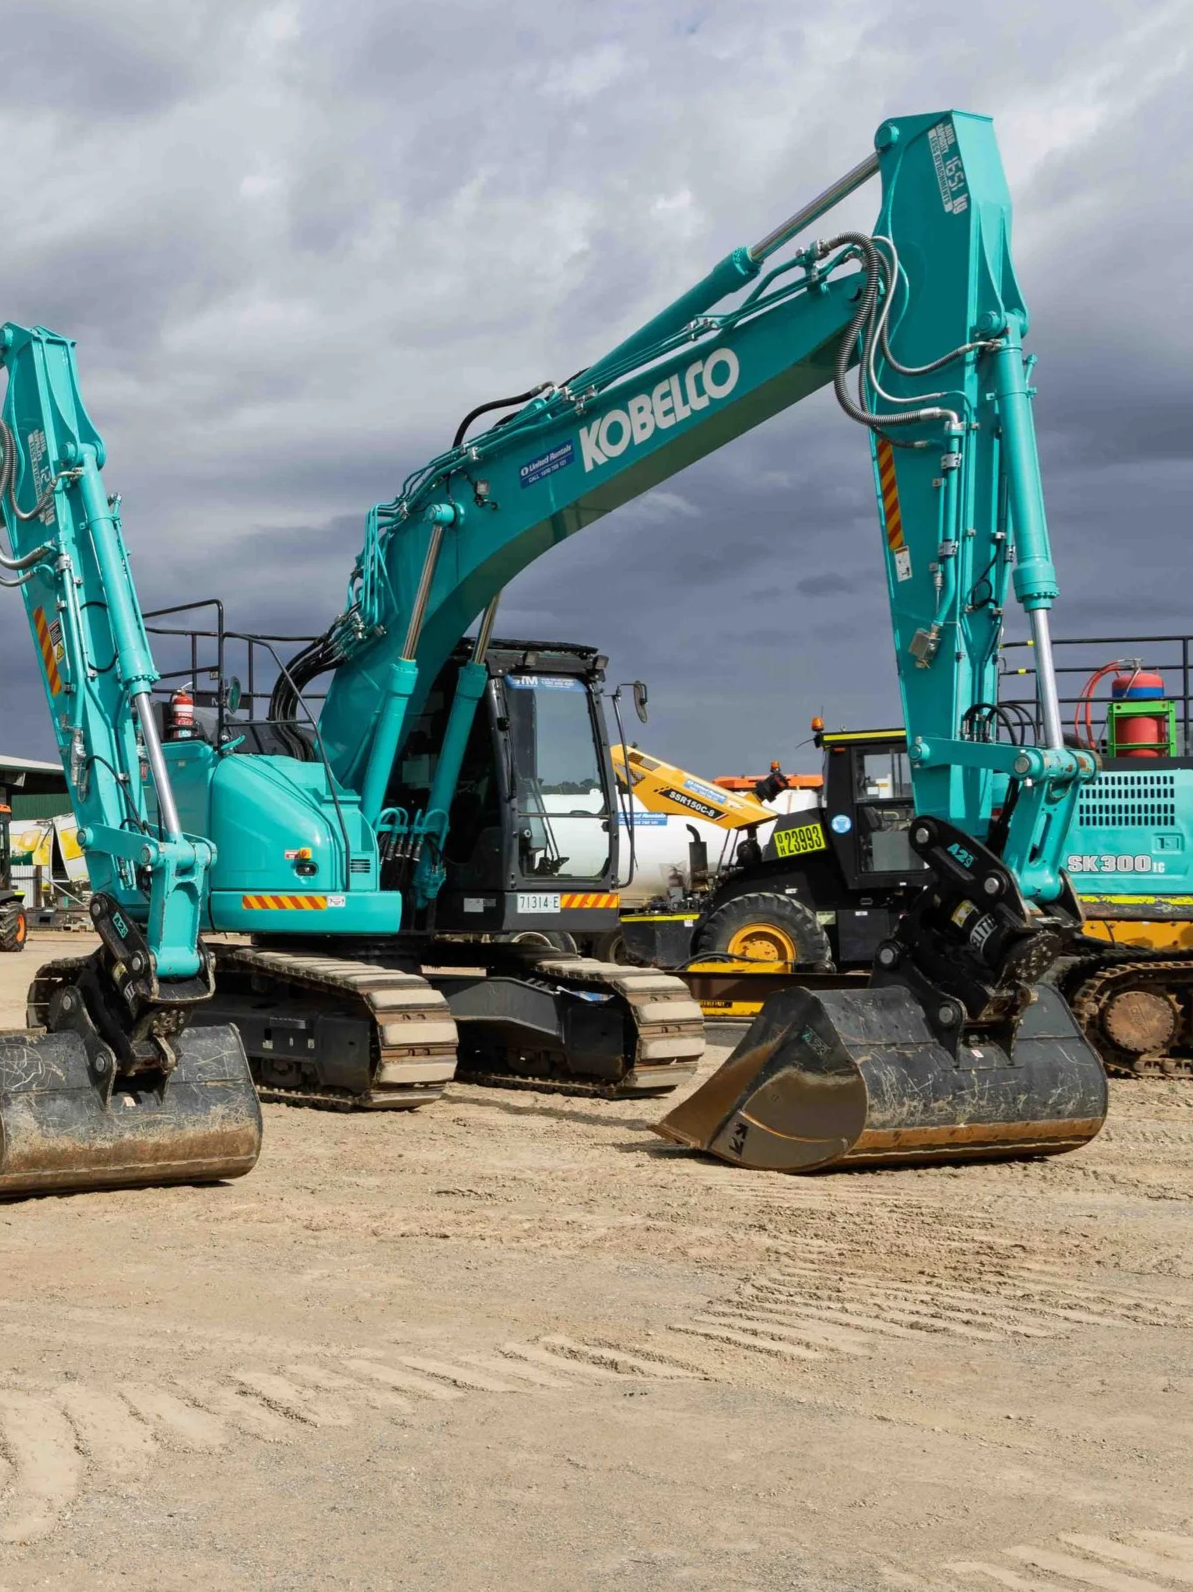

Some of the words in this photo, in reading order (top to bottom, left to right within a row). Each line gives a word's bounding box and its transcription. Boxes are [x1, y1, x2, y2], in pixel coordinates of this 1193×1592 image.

[579, 348, 739, 473] KOBELCO
[529, 455, 549, 472] United
[549, 444, 572, 461] Rentals
[669, 790, 716, 817] SSR150C-8
[785, 825, 822, 854] 23993
